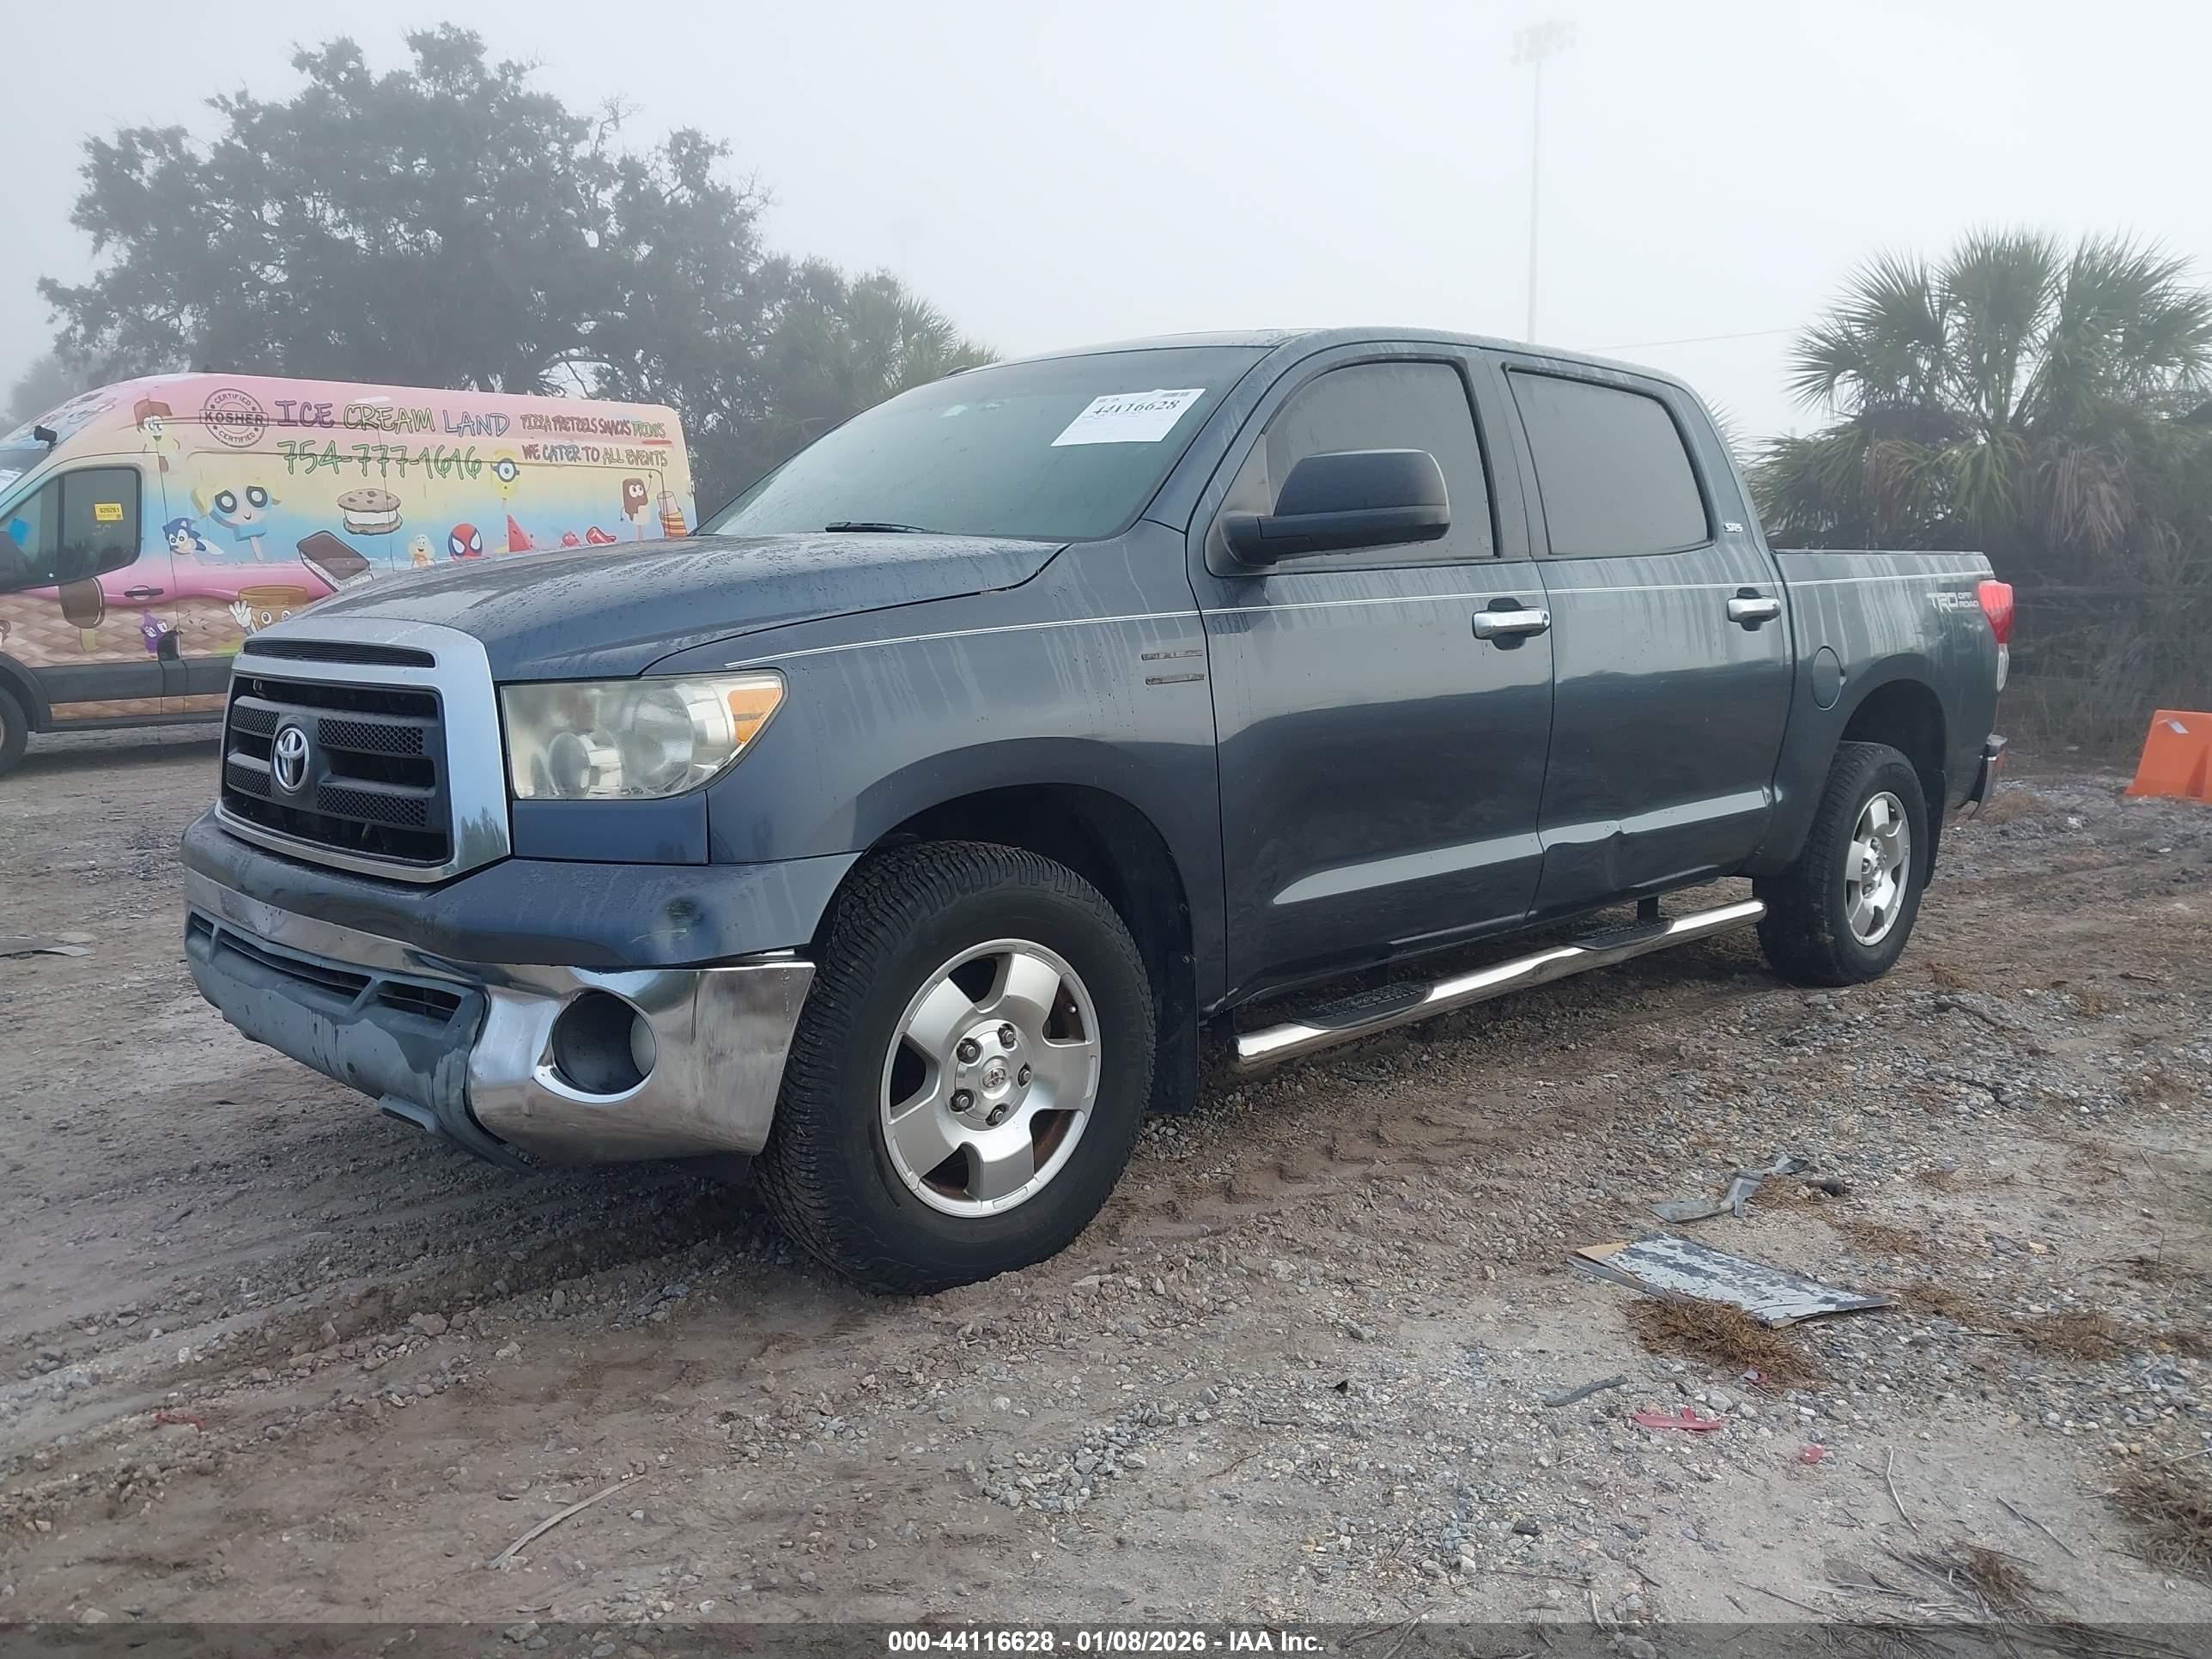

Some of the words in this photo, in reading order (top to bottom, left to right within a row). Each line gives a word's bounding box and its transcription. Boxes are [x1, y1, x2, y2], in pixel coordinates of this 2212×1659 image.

[214, 392, 252, 406] CERTIFIED
[204, 411, 264, 426] KOSHER
[275, 400, 335, 428] ICE
[343, 403, 436, 434] CREAM
[442, 410, 510, 438] LAND
[520, 413, 551, 432] PIZZA
[551, 415, 599, 434] PRETZELS
[598, 417, 632, 437] SNACKS
[631, 420, 666, 439] DRINKS
[219, 430, 256, 443] CERTIFIED
[276, 440, 482, 480] 754-777-1616
[521, 443, 541, 460] WE
[542, 444, 582, 463] CATER
[581, 446, 600, 463] TO
[602, 447, 624, 465] ALL
[625, 449, 668, 467] EVENTS
[1926, 592, 1959, 614] TRD
